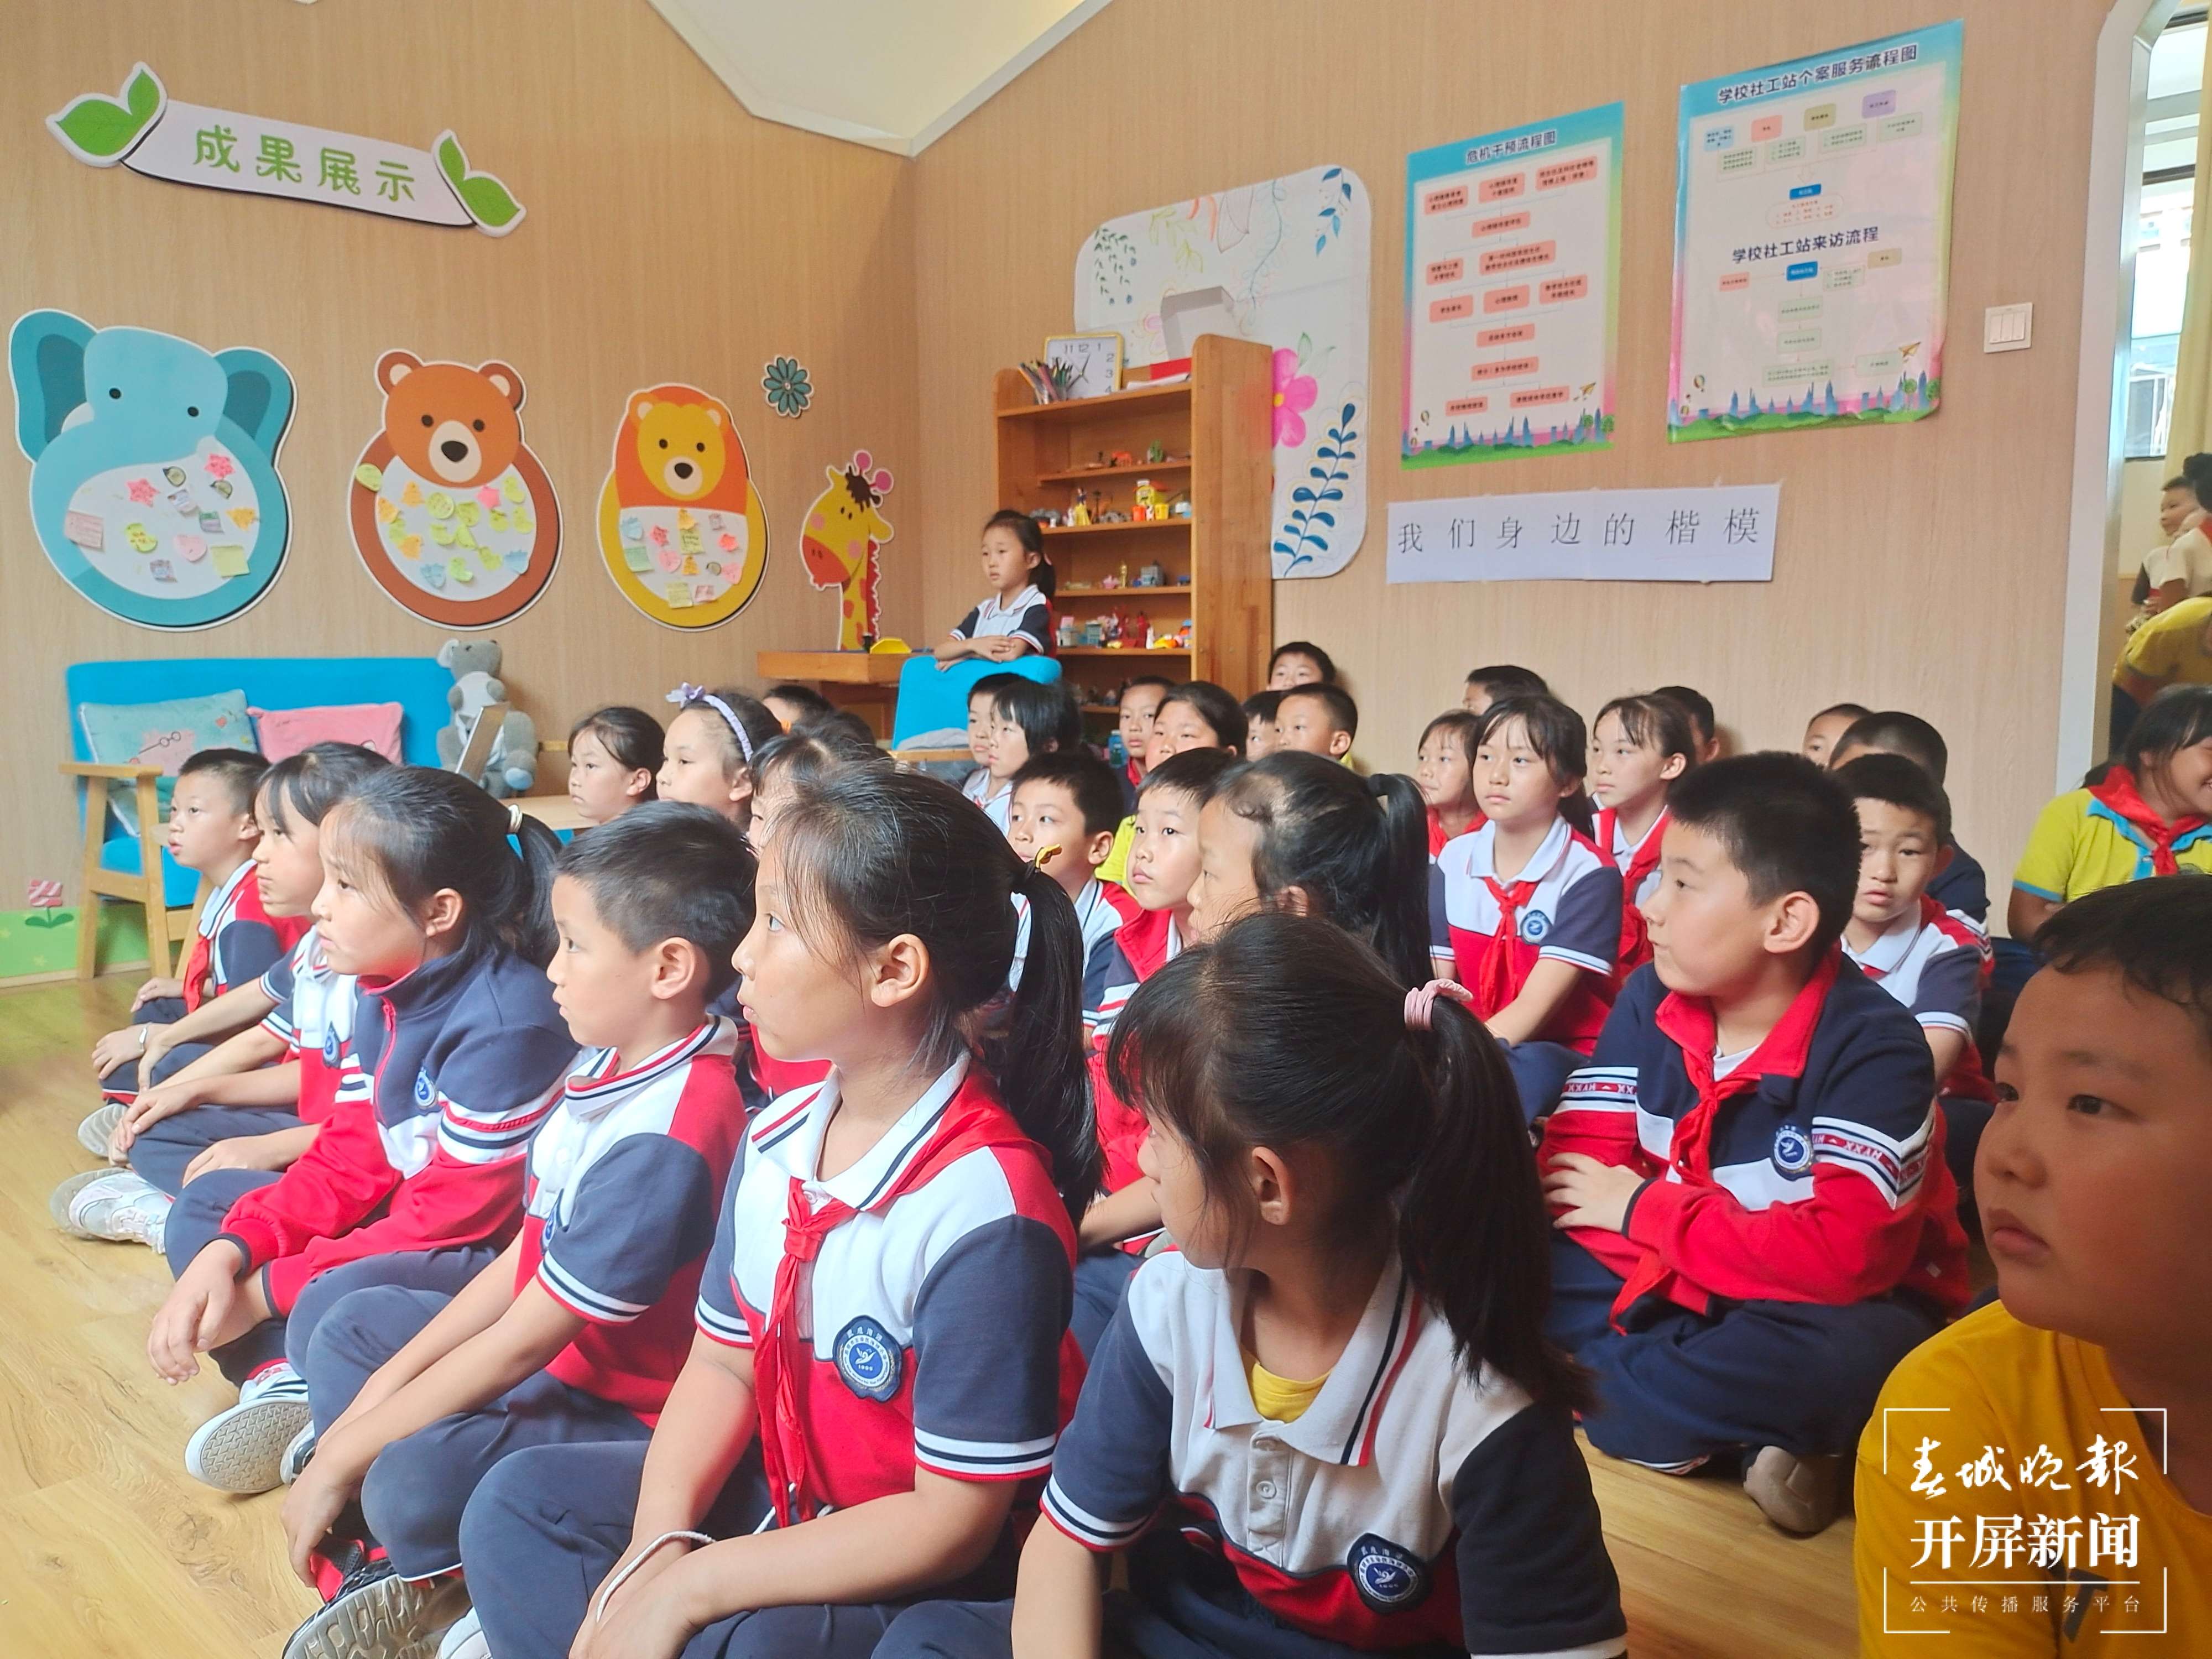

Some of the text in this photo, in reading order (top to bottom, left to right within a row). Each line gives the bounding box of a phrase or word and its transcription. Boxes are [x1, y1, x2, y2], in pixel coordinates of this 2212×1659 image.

[1718, 44, 1918, 103] 学校社工站个案服务流程图
[193, 124, 415, 202] 成果展示
[1732, 226, 1879, 263] 学校社工站来访流程
[1078, 344, 1089, 353] 12
[1106, 353, 1115, 362] 2
[1106, 369, 1113, 378] 3
[1398, 508, 1760, 553] 我们身边的楷模
